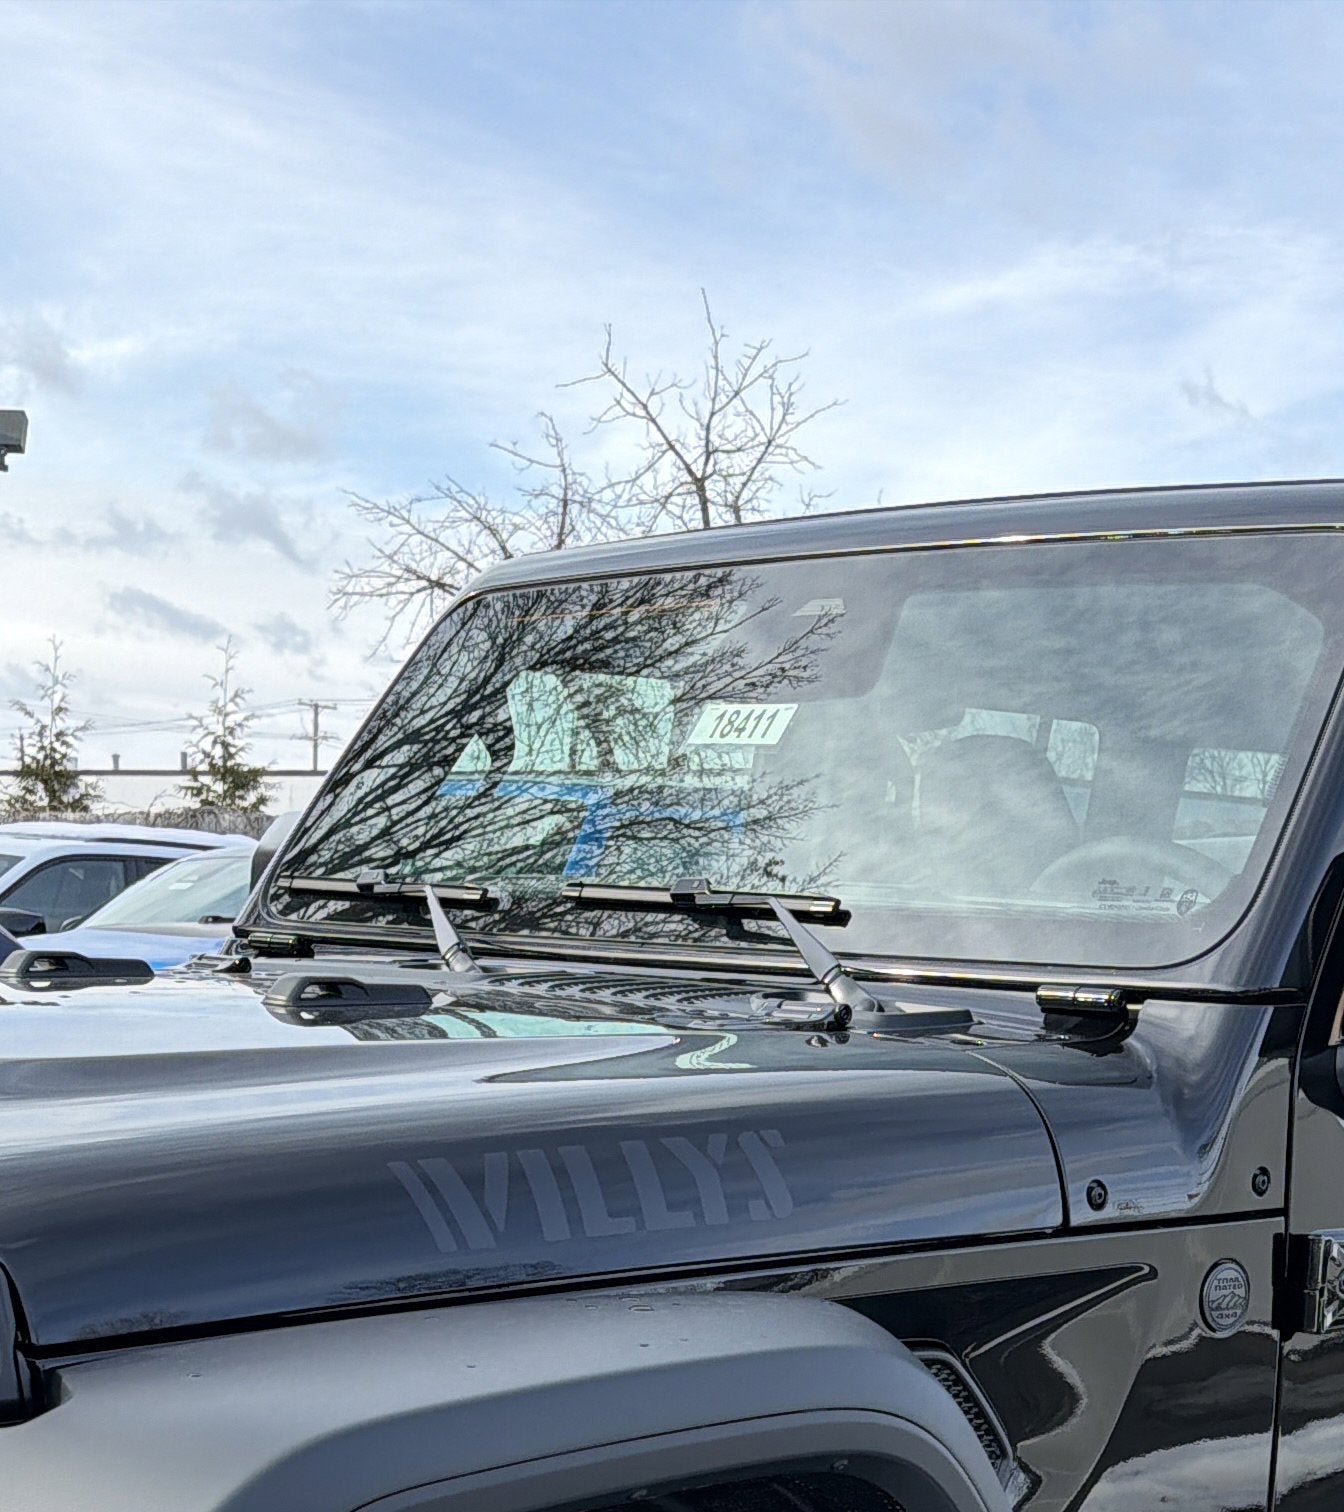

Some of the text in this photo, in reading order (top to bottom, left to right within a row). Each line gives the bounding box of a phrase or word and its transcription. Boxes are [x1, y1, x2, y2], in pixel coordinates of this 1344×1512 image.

[709, 709, 780, 738] 18411
[387, 1130, 793, 1253] WILLYS
[1214, 1283, 1243, 1292] RATED
[1216, 1276, 1241, 1285] TRAIL
